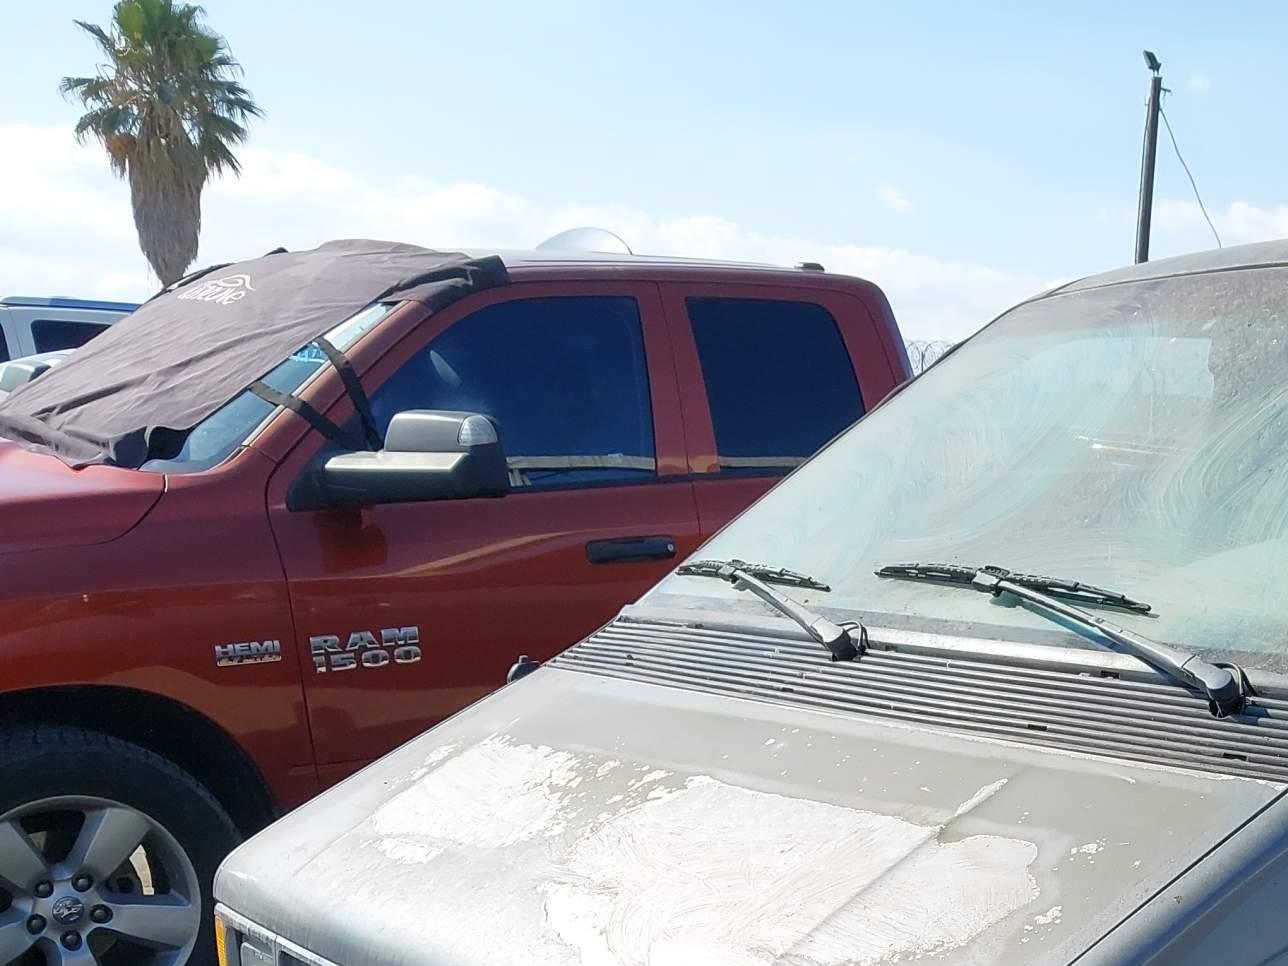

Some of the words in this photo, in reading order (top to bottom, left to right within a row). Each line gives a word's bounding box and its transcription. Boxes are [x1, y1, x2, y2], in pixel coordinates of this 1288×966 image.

[214, 639, 281, 658] HEMI
[309, 626, 420, 654] RAM
[312, 645, 422, 674] 1500
